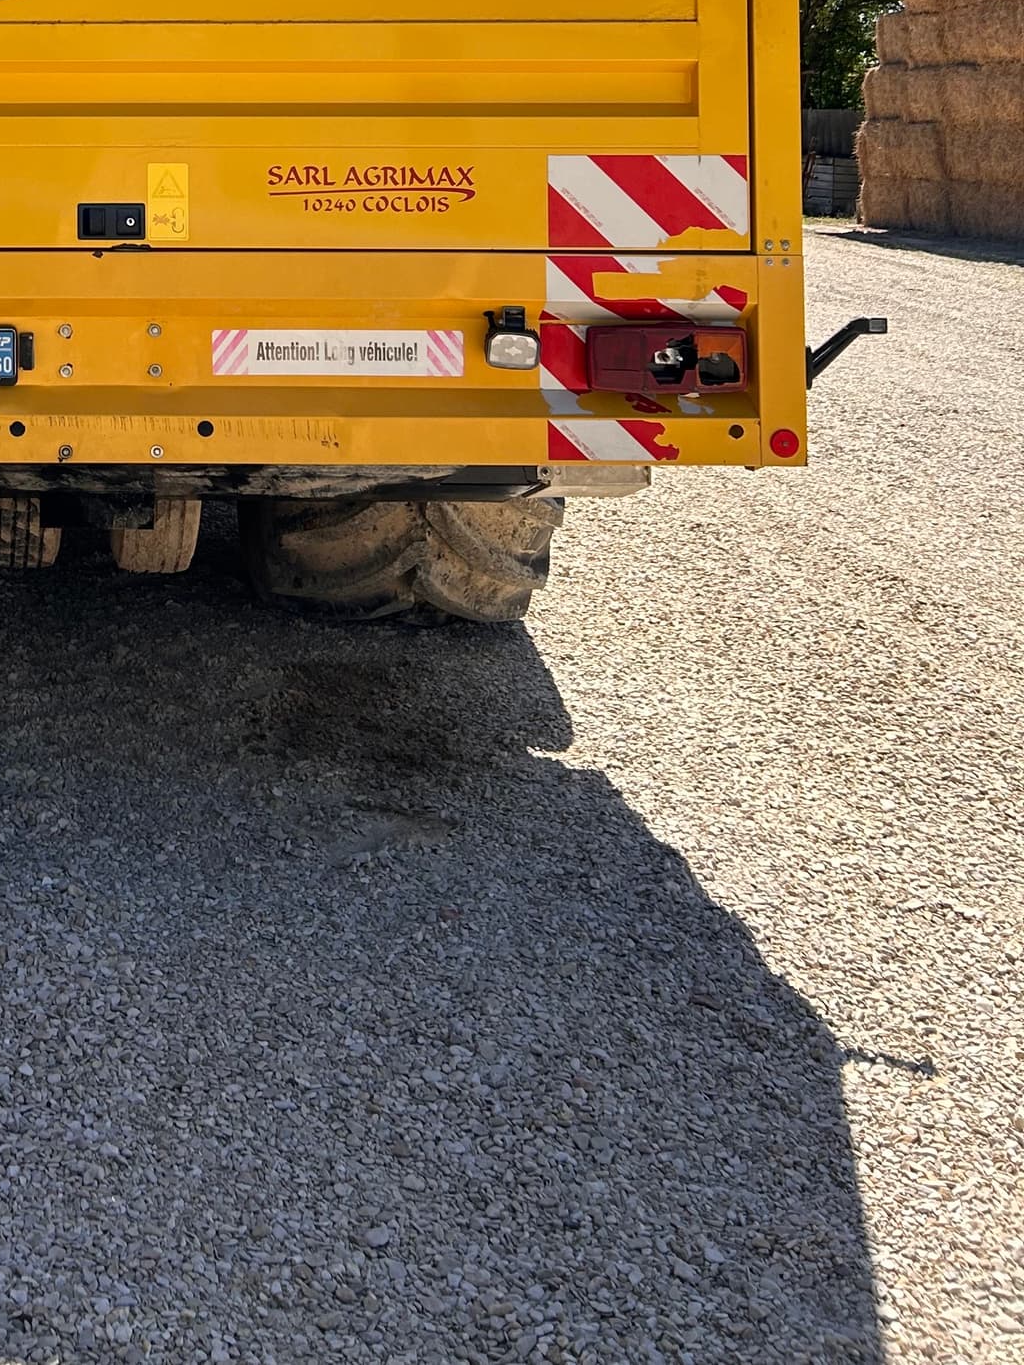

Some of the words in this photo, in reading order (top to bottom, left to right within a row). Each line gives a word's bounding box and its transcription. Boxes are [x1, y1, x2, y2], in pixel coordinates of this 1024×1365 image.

[267, 166, 336, 186] SARL
[343, 166, 475, 187] AGRIMAX
[303, 198, 356, 212] 10240
[362, 196, 450, 213] COCLOIS
[256, 342, 320, 361] Attention!
[324, 342, 355, 365] Log
[359, 342, 418, 361] véhicule!
